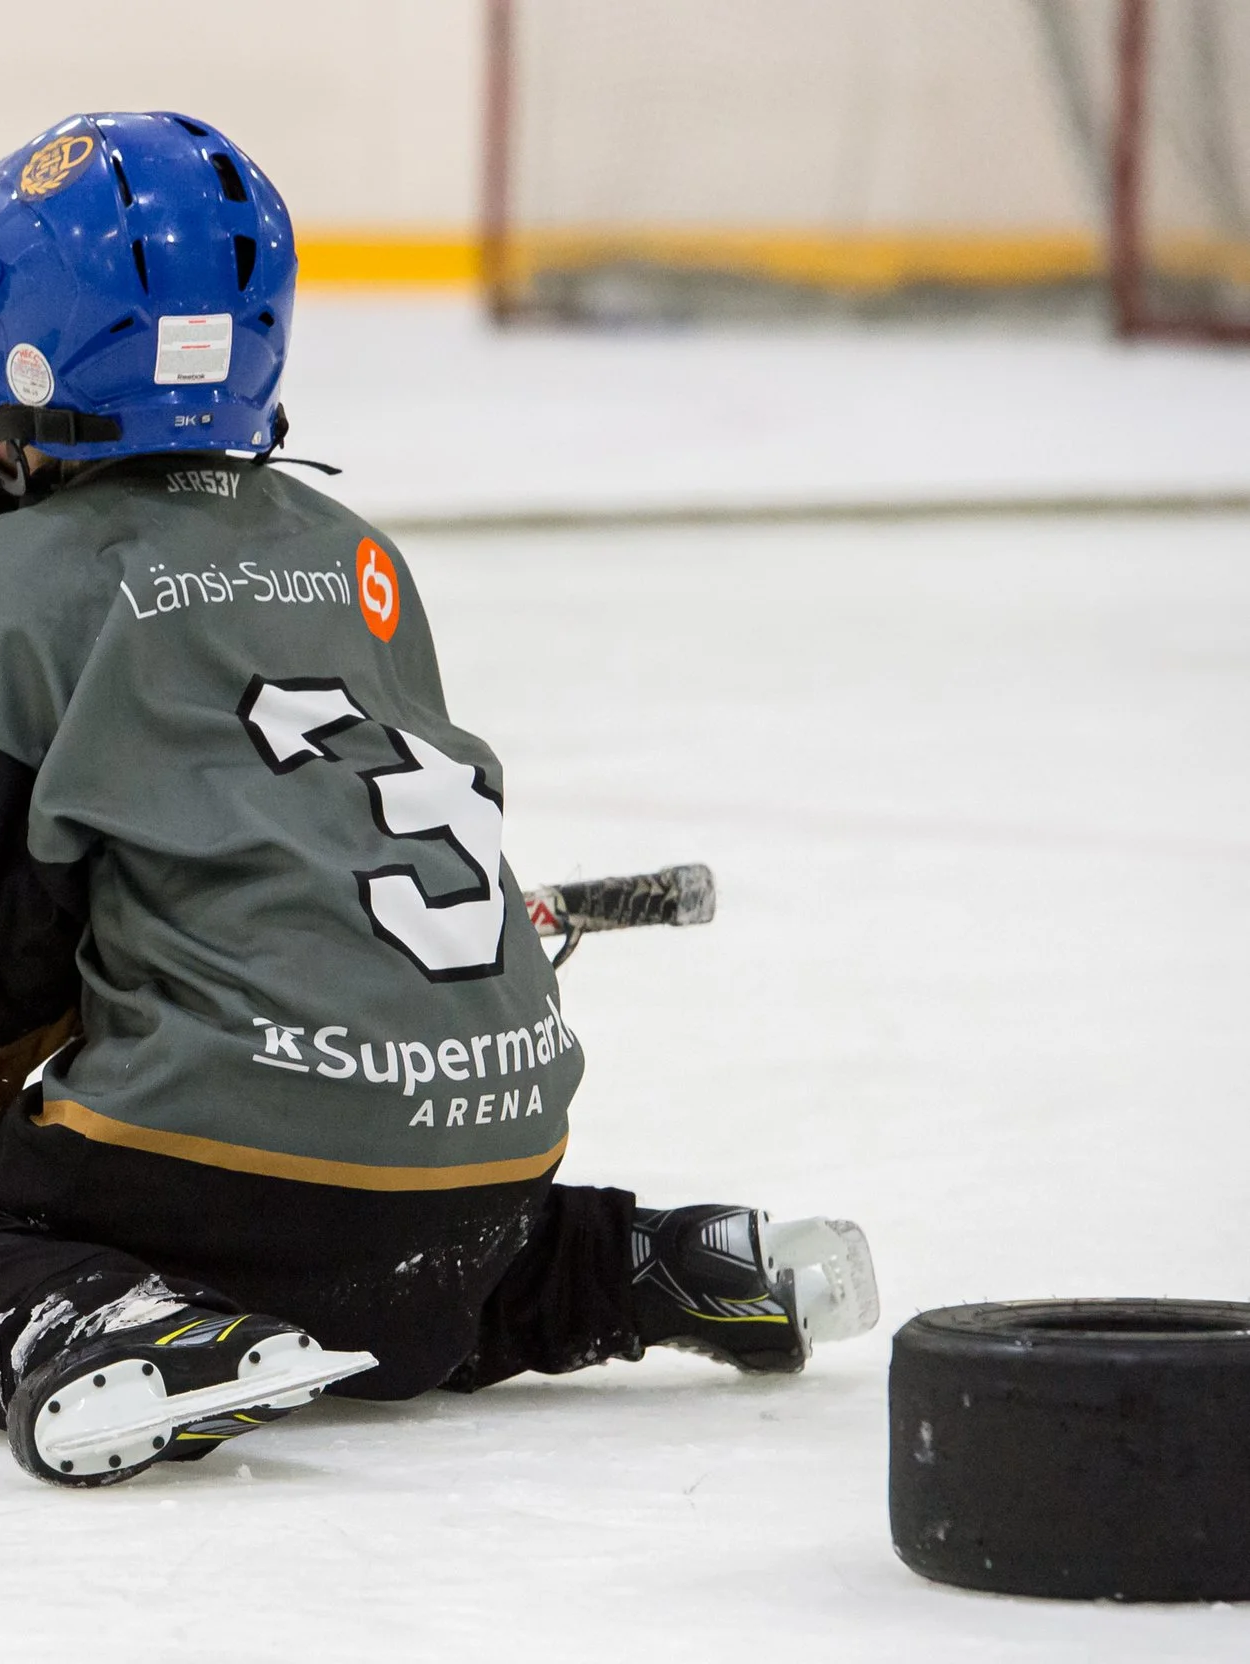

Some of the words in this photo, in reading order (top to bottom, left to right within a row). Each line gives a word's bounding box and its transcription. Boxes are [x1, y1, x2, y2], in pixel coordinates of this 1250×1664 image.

[120, 560, 350, 619] Länsi-Suomi
[312, 993, 575, 1096] Supermark
[408, 1084, 543, 1128] ARENA
